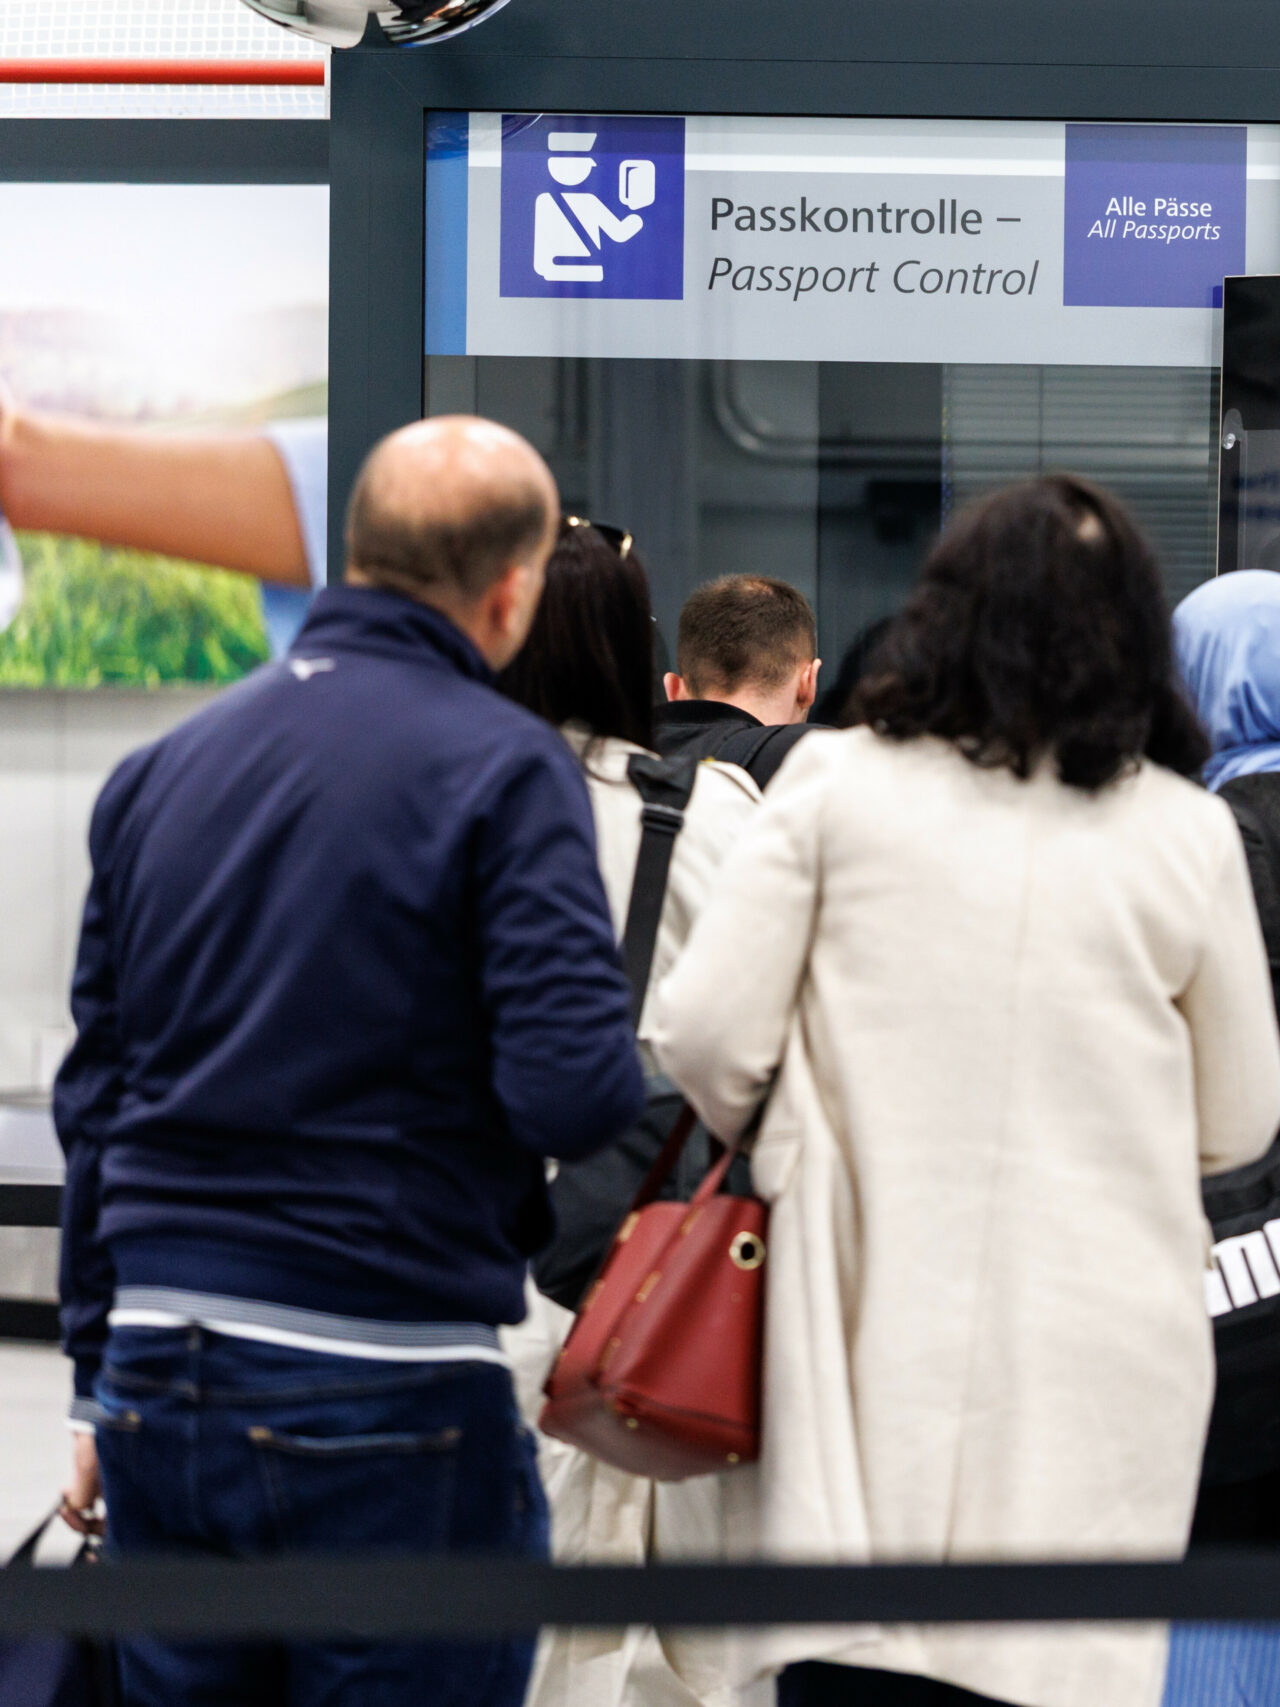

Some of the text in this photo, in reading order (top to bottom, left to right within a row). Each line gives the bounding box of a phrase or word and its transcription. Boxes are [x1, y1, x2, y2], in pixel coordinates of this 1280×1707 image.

[711, 196, 983, 235] Passkontrolle
[1105, 196, 1212, 217] Alle Pässe
[1087, 219, 1222, 245] All Passports
[707, 257, 1040, 302] Passport Control
